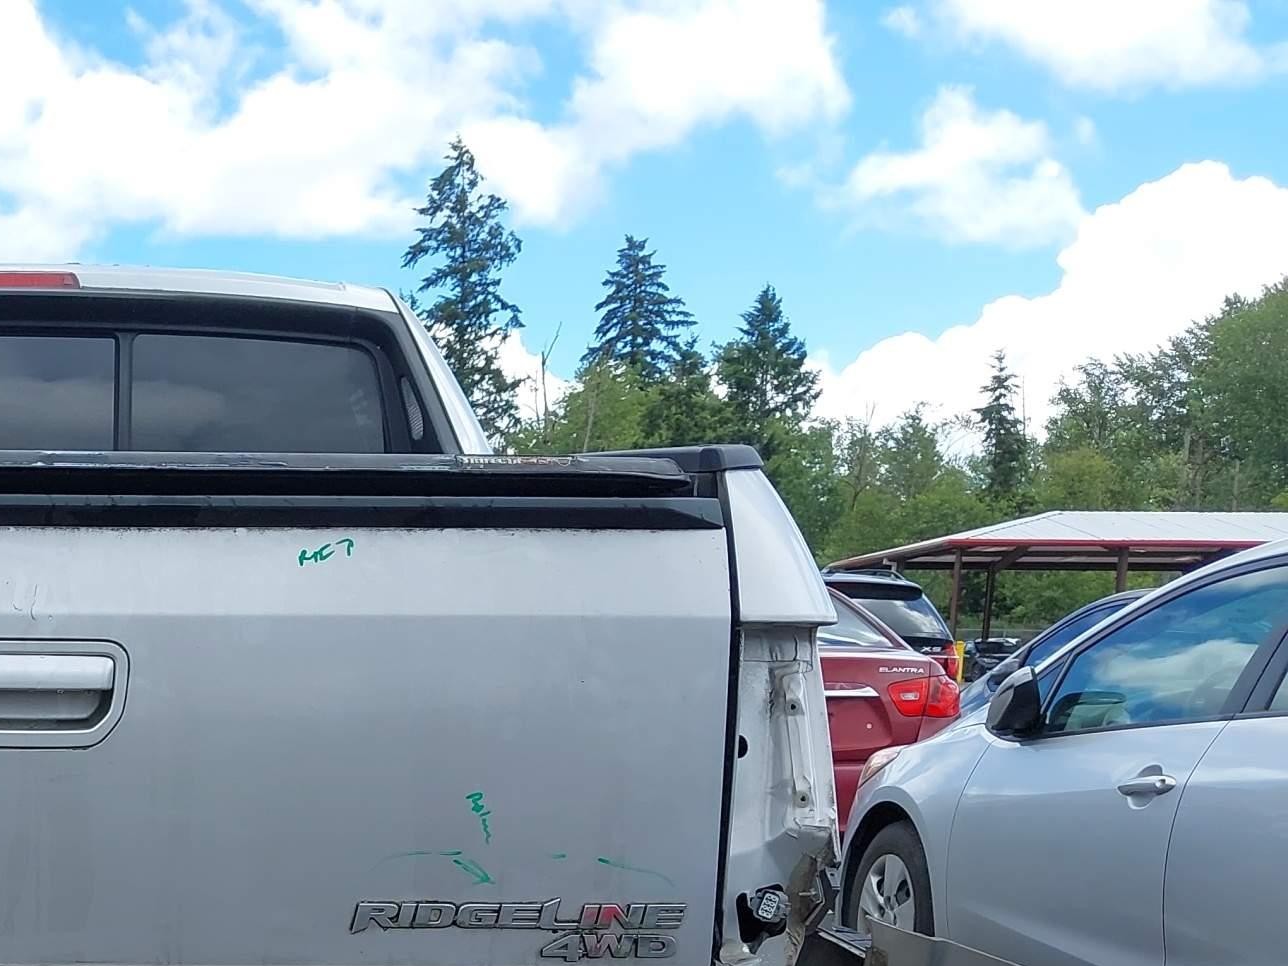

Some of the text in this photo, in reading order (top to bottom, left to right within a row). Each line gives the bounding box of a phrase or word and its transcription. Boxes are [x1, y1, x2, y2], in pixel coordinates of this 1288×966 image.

[878, 666, 925, 674] ELANTRA
[349, 897, 688, 934] RIDGELINE
[540, 932, 678, 962] 4WD
